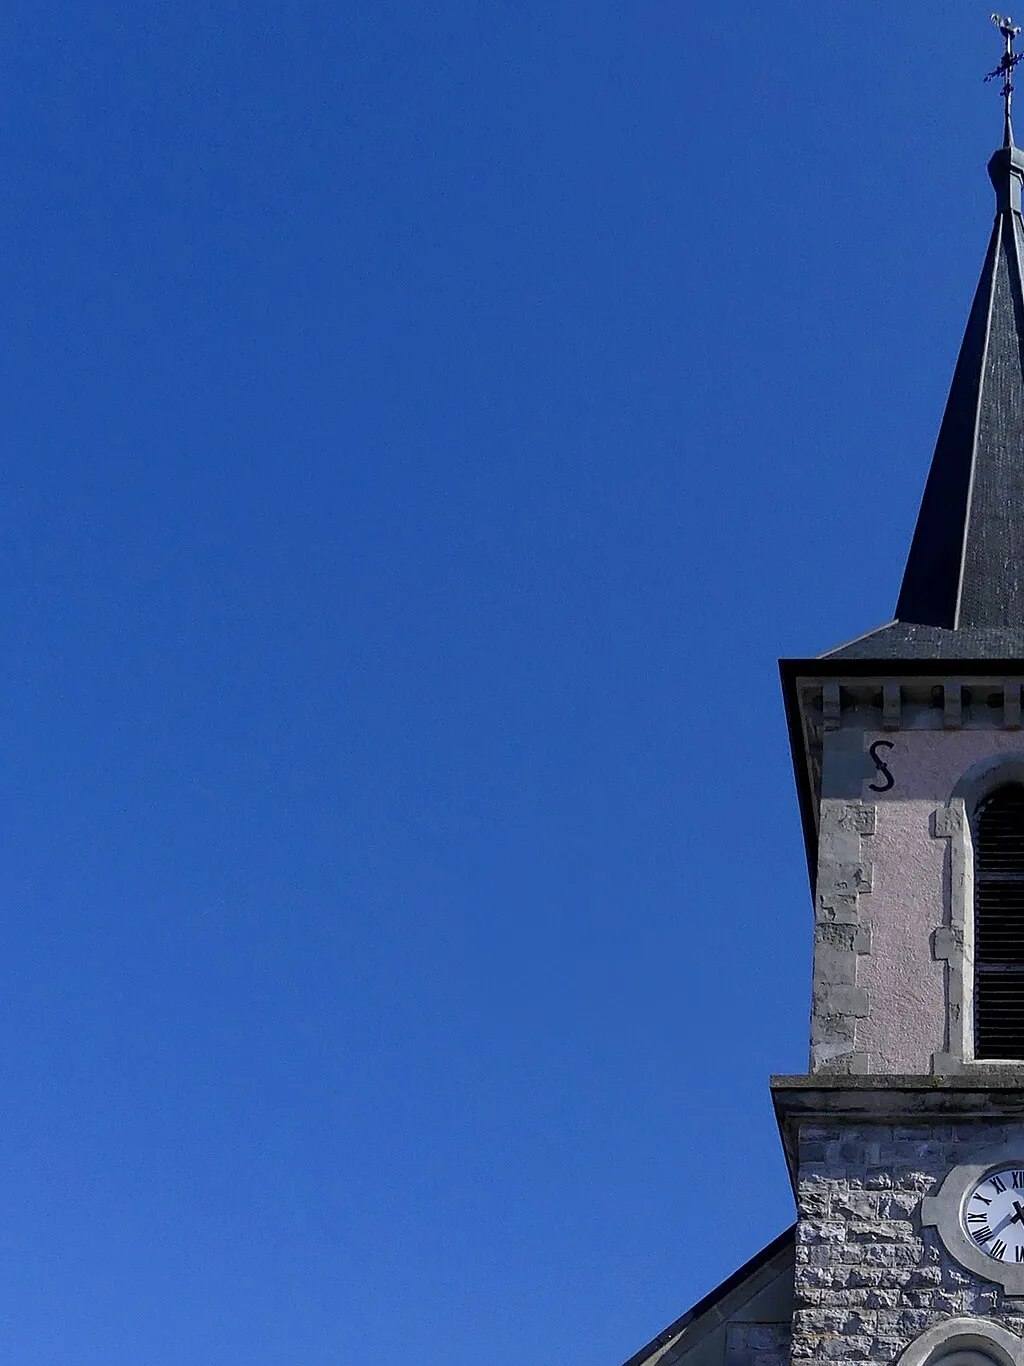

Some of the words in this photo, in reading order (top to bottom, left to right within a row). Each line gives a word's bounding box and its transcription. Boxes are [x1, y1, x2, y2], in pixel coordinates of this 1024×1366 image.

[989, 1176, 1007, 1195] XI
[973, 1193, 992, 1206] X
[967, 1213, 988, 1223] IX
[972, 1225, 994, 1246] VIII
[990, 1239, 1008, 1260] VII
